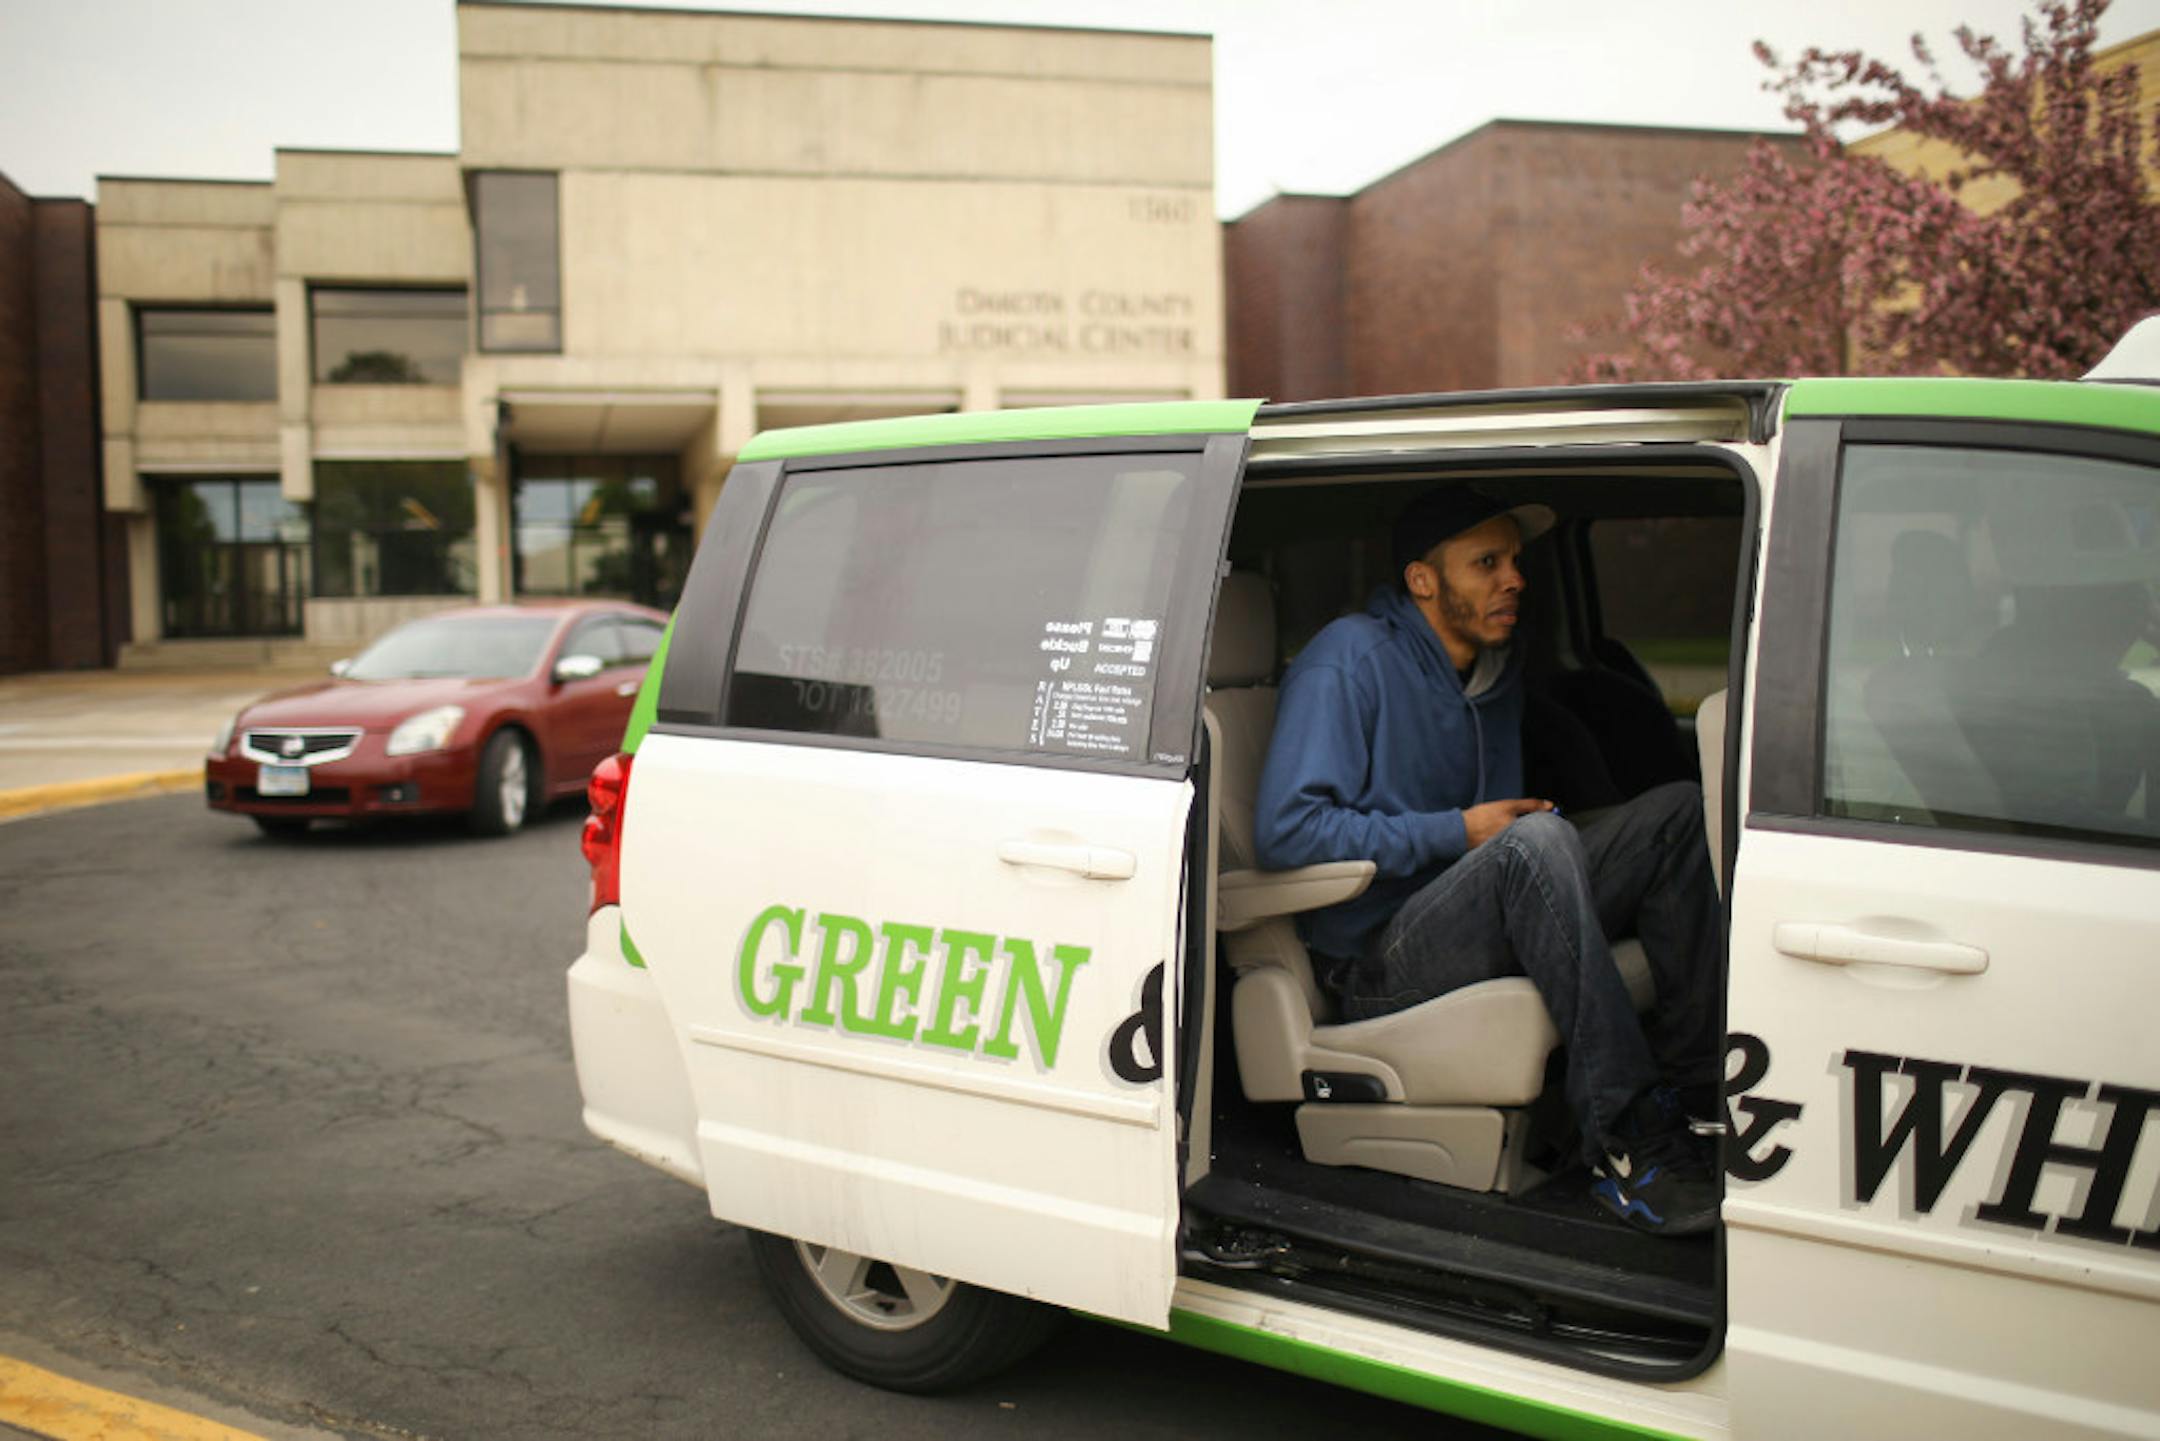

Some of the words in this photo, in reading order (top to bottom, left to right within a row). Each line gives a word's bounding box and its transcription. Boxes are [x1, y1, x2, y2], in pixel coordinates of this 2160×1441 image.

[955, 287, 1064, 316] DAKOTA
[1080, 288, 1194, 316] COUNTY
[937, 320, 1069, 353] JUDICIAL
[1080, 323, 1195, 353] CENTER
[1093, 664, 1147, 677] ACCEPTED
[738, 903, 1092, 1070] GREEN
[1842, 1048, 2160, 1249] WH
